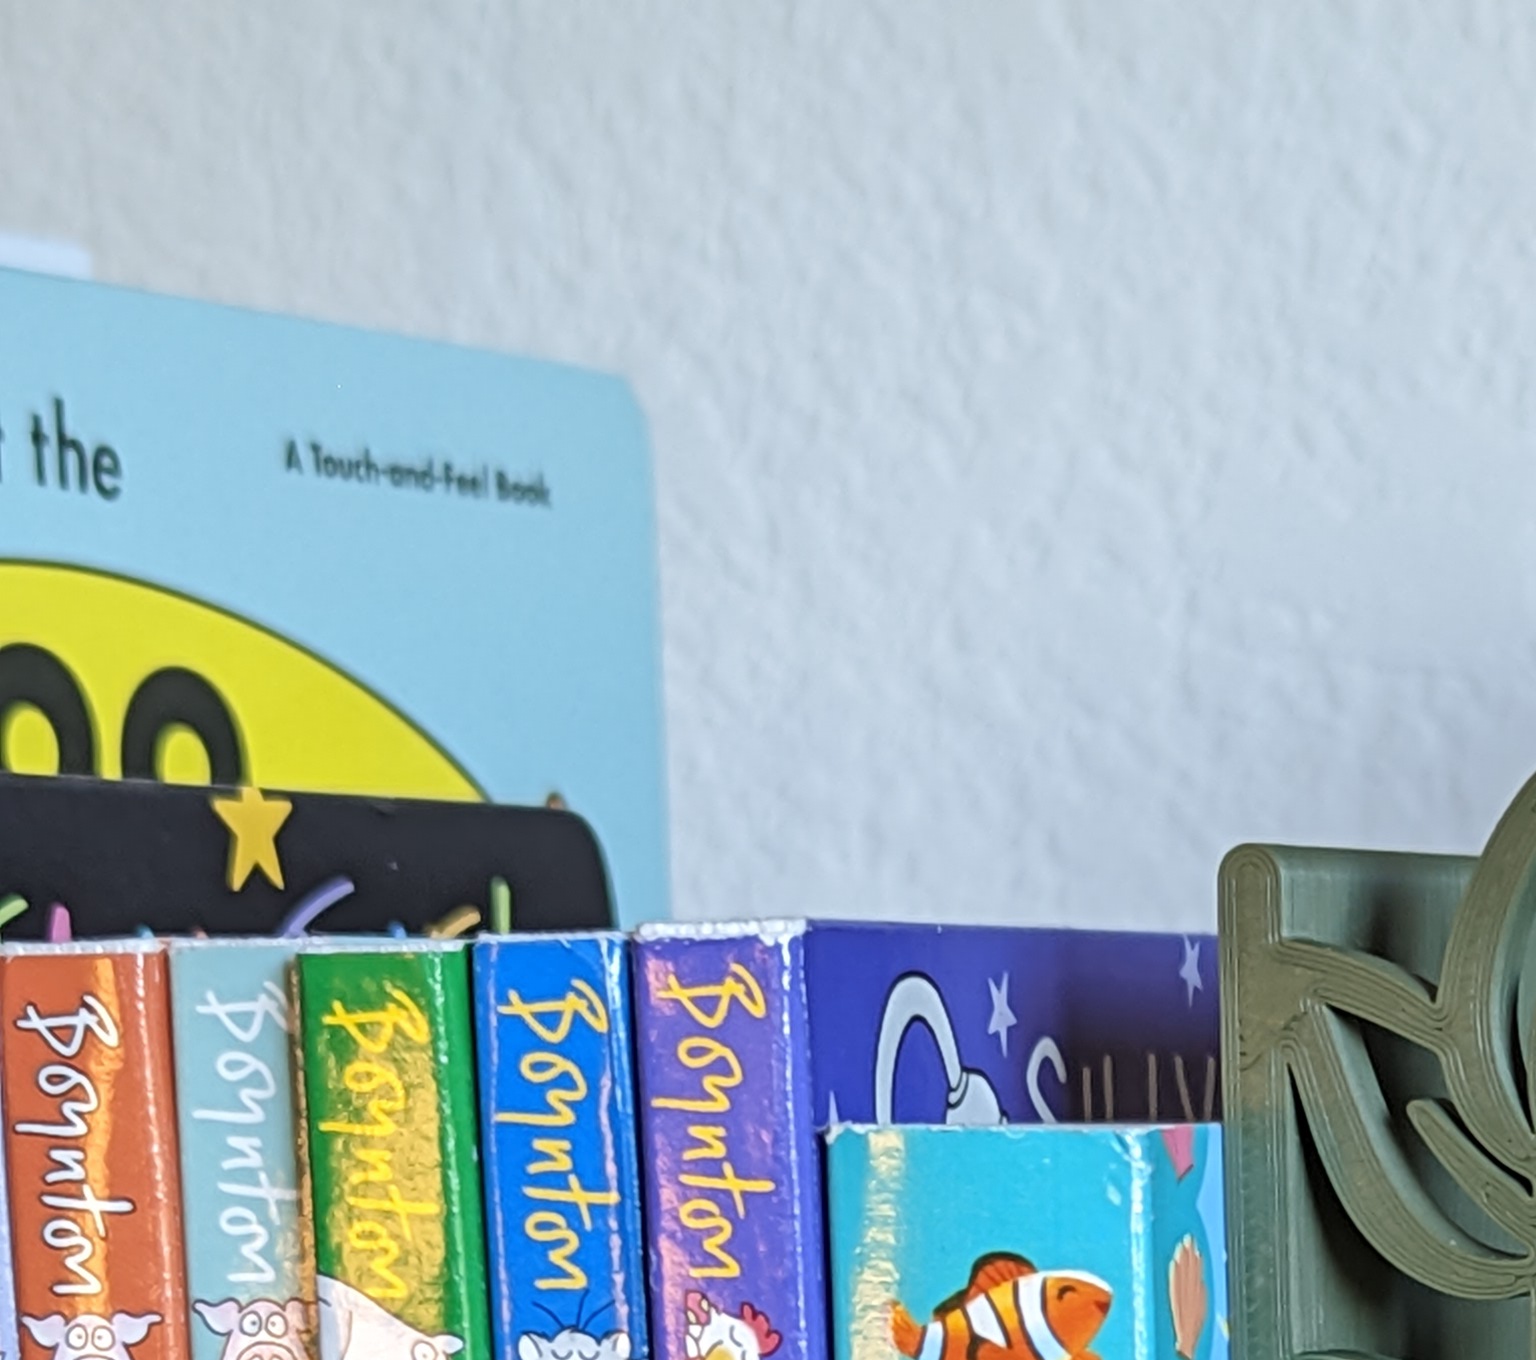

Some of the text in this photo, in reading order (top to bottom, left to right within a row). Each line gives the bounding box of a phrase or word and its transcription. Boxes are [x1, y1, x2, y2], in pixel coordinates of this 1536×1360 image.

[30, 396, 123, 502] the
[284, 438, 303, 476] A
[494, 467, 553, 509] Book
[15, 994, 134, 1295] Boynton
[191, 980, 299, 1283] Boynton
[319, 979, 442, 1298] Boynton
[495, 979, 621, 1291] Boynton
[651, 963, 775, 1278] Boynton
